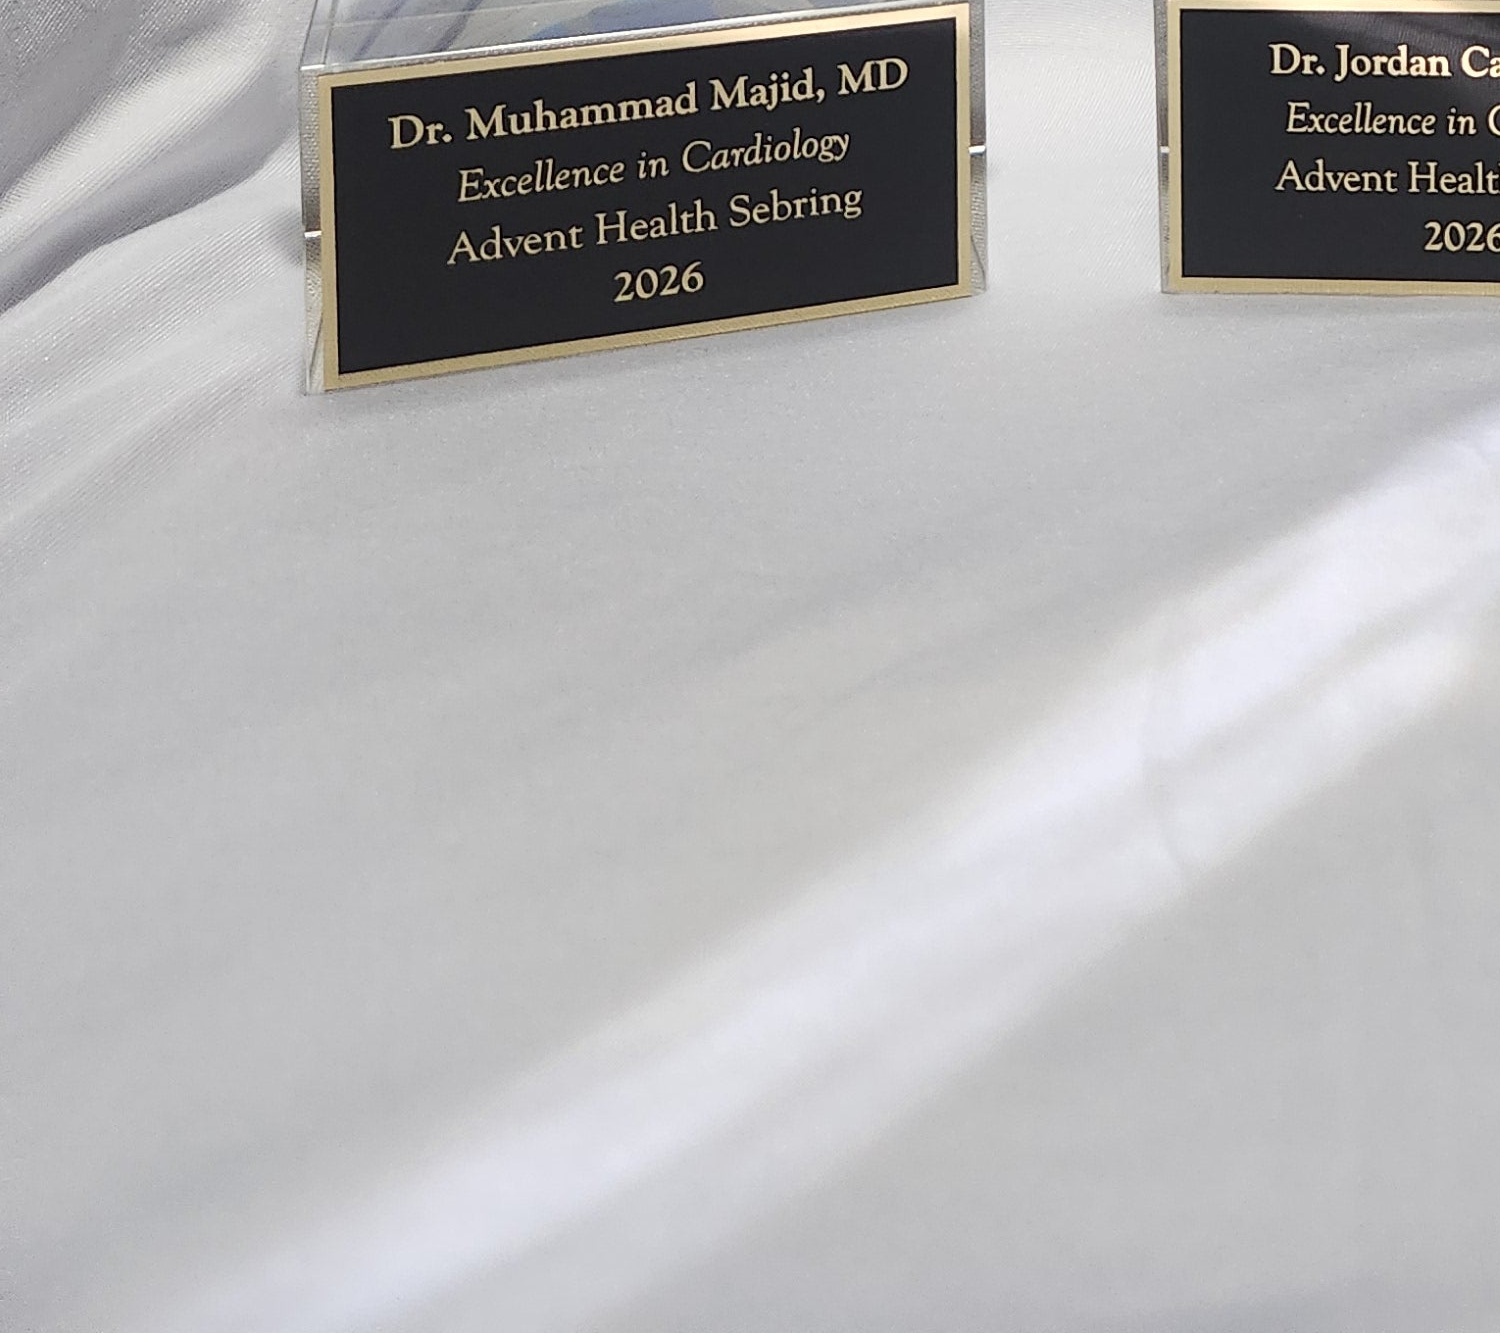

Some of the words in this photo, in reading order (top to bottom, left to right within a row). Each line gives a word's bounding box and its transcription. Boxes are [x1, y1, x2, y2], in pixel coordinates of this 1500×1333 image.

[1268, 43, 1325, 75] Dr.
[1334, 44, 1453, 82] Jordan
[387, 115, 453, 149] Dr.
[464, 81, 699, 140] Muhammad
[709, 67, 825, 111] Majid,
[837, 58, 908, 95] MD
[1286, 101, 1436, 135] Excellence
[1446, 107, 1477, 135] in
[458, 158, 625, 202] Excellence
[637, 152, 669, 179] in
[682, 127, 850, 173] Cardiology
[1275, 158, 1398, 193] Advent
[447, 225, 583, 265] Advent
[595, 199, 718, 245] Health
[729, 188, 862, 227] Sebring
[614, 261, 704, 302] 2026
